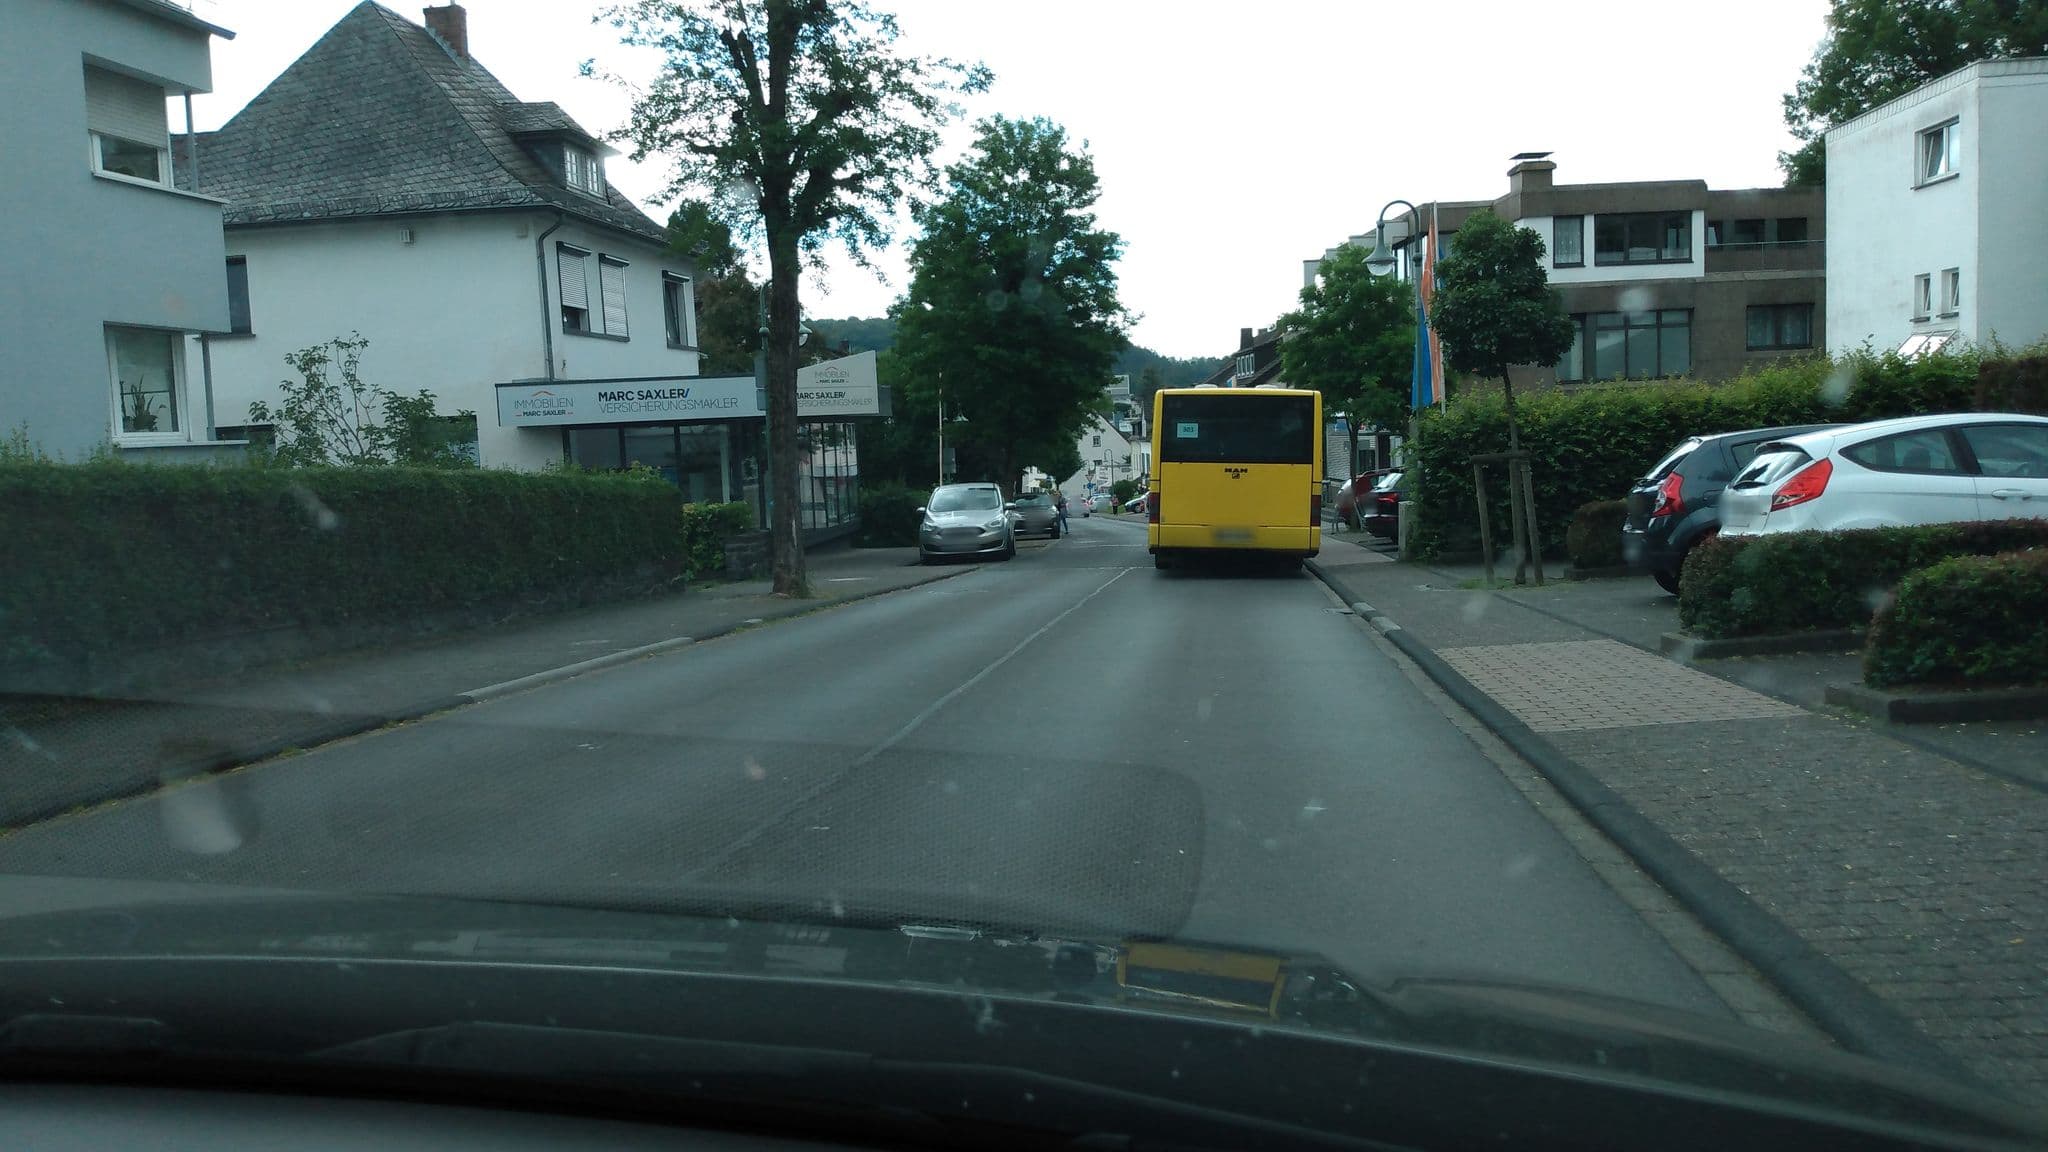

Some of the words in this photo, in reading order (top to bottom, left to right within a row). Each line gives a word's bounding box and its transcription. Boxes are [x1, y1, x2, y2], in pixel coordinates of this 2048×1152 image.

[598, 390, 635, 402] MARC
[514, 397, 574, 409] IMMOBILIEN
[600, 397, 739, 413] VERSICHERUNGSMAKLER
